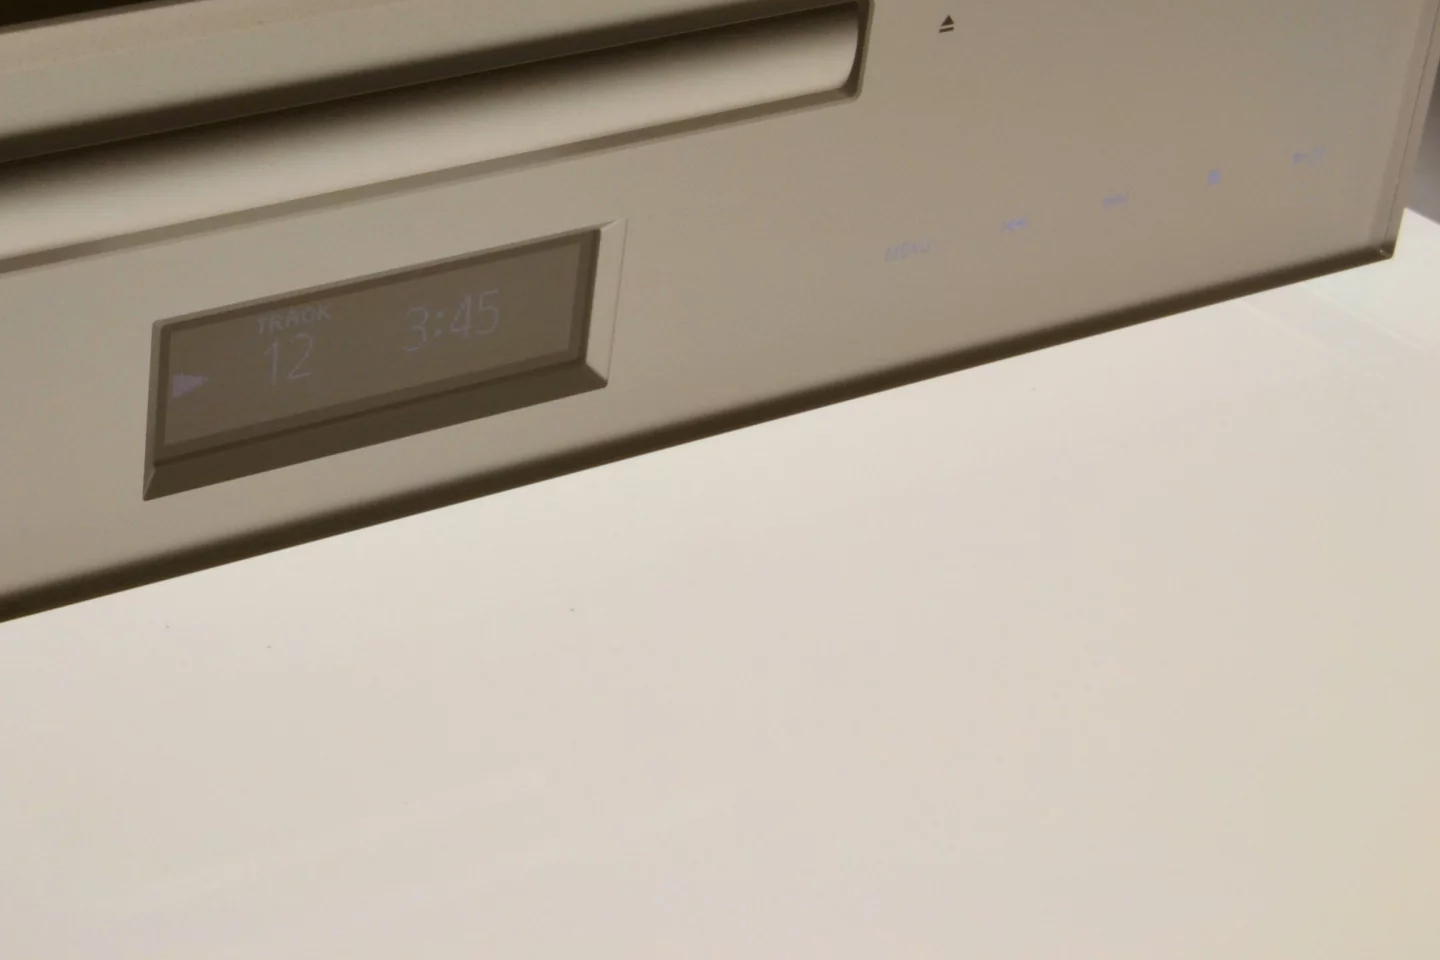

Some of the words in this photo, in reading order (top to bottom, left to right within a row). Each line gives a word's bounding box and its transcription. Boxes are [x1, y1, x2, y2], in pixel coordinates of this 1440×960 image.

[256, 305, 333, 335] TRACK
[402, 288, 500, 353] 3:45
[263, 332, 316, 386] 12
